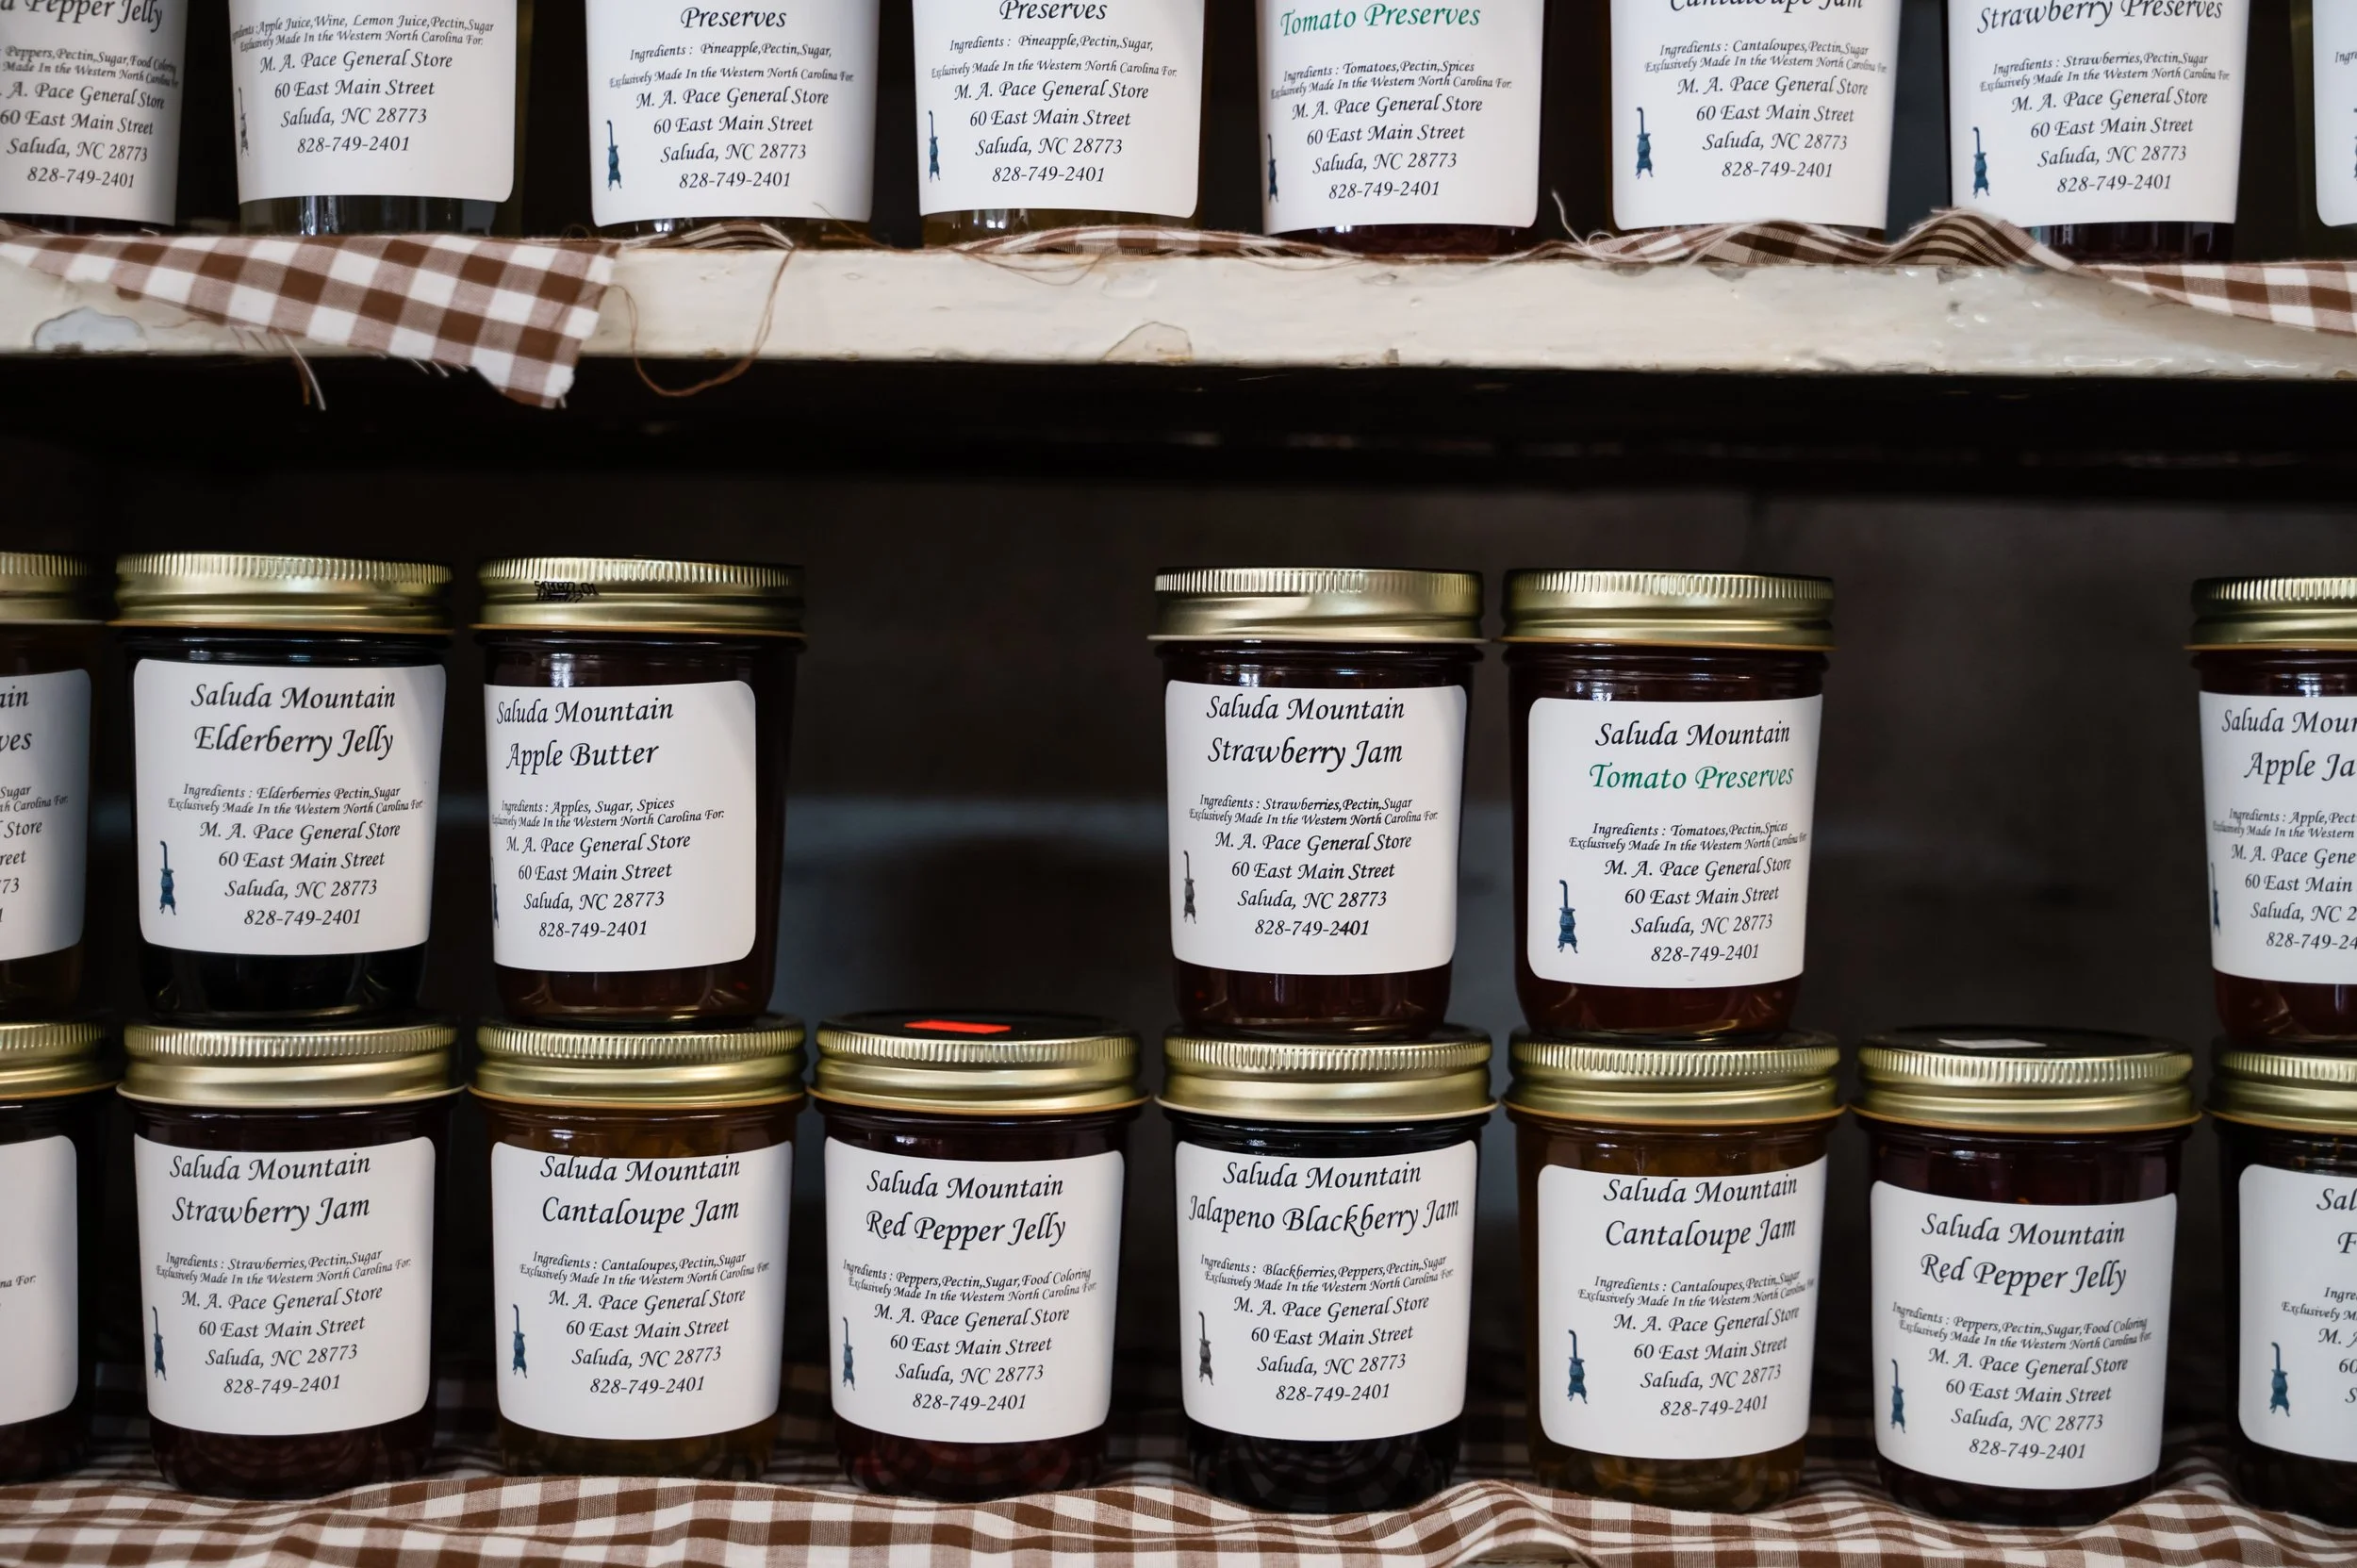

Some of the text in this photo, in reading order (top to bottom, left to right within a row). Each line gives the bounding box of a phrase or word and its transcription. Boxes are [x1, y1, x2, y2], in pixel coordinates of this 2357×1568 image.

[680, 7, 787, 29] Preserves
[998, 0, 1108, 21] Preserves
[1279, 2, 1481, 38] Tomato Preserves
[1976, 0, 2223, 34] Strawberry Preserves
[274, 78, 436, 99] 60 East Main Street
[280, 106, 427, 128] Saluda, NC 28773
[6, 136, 148, 163] Saluda, NC 28773
[297, 135, 409, 154] 828-749-2401
[974, 135, 1123, 157] Saluda, NC 28773
[1702, 130, 1848, 151] Saluda, NC 28773
[659, 141, 806, 164] Saluda, NC 28773
[1311, 152, 1457, 174] Saluda, NC 28773
[26, 166, 135, 189] 828-749-2401
[679, 171, 790, 189] 828-749-2401
[992, 165, 1105, 183] 828-749-2401
[1721, 160, 1833, 178] 828-749-2401
[1328, 180, 1440, 200] 828-749-2401
[2056, 173, 2171, 193] 828-749-2401
[190, 681, 396, 710] Saluda Mountain
[1206, 692, 1405, 721] Saluda Mountain
[496, 697, 674, 725] Saluda Mountain
[2220, 706, 2285, 733] Saluda
[193, 722, 394, 763] Elderberry Jelly
[1594, 719, 1790, 747] Saluda Mountain
[505, 739, 660, 776] Apple Butter
[1207, 735, 1403, 773] Strawberry Jam
[1589, 761, 1795, 790] Tomato Preserves
[2243, 749, 2316, 785] Apple
[183, 783, 246, 799] Ingredients
[255, 787, 332, 800] Elderberries
[1199, 794, 1254, 810] Ingredients
[12, 795, 52, 814] Carolina
[168, 798, 221, 813] Exclusively
[222, 801, 255, 814] Made
[256, 803, 271, 815] In
[273, 803, 292, 815] the
[294, 803, 340, 815] Western
[342, 801, 374, 815] North
[375, 801, 409, 814] Carolina
[502, 798, 543, 814] Ingredients
[636, 799, 675, 812] Spices
[3, 819, 44, 839] Store
[1188, 811, 1233, 824] Exclusively
[1233, 813, 1263, 824] Made
[1265, 814, 1278, 825] In
[1281, 815, 1299, 825] the
[1301, 815, 1348, 826] Western
[1349, 814, 1382, 826] North
[1383, 813, 1422, 825] Carolina
[199, 819, 402, 846] M. A. General General Store
[518, 863, 673, 882] 60 East Main Street
[243, 908, 361, 927] 828-749-2401
[538, 919, 647, 938] 828-749-2401
[1254, 918, 1370, 936] 828-749-2401
[1650, 943, 1759, 963] 828-749-2401
[169, 1153, 371, 1181] Saluda Mountain
[539, 1154, 741, 1183] Saluda Mountain
[1222, 1160, 1422, 1190] Saluda Mountain
[865, 1169, 1063, 1199] Saluda Mountain
[1603, 1174, 1798, 1204] Saluda Mountain
[172, 1196, 371, 1232] Strawberry Jam
[542, 1196, 739, 1234] Cantaloupe Jam
[1188, 1195, 1459, 1238] Jalapeno Blackberry Jam
[865, 1209, 1066, 1251] Red Pepper Jelly
[1605, 1217, 1796, 1255] Cantaloupe Jam
[1920, 1213, 2125, 1246] Saluda Mountain
[519, 1264, 569, 1282] Exclusively
[569, 1272, 601, 1284] Made
[602, 1274, 616, 1285] In
[618, 1275, 636, 1286] the
[638, 1275, 684, 1286] Western
[685, 1270, 717, 1284] North
[719, 1266, 755, 1281] Carolina
[1920, 1253, 2127, 1297] Red Pepper Jelly
[1233, 1295, 1430, 1324] M. A. General General Store
[895, 1362, 1044, 1386] Saluda, NC 28773
[1928, 1347, 2130, 1381] M. A. General General Store
[223, 1374, 340, 1395] 828-749-2401
[589, 1375, 704, 1395] 828-749-2401
[1275, 1382, 1390, 1402] 828-749-2401
[912, 1393, 1027, 1411] 828-749-2401
[1659, 1395, 1768, 1417] 828-749-2401
[1969, 1438, 2085, 1460] 828-749-2401
